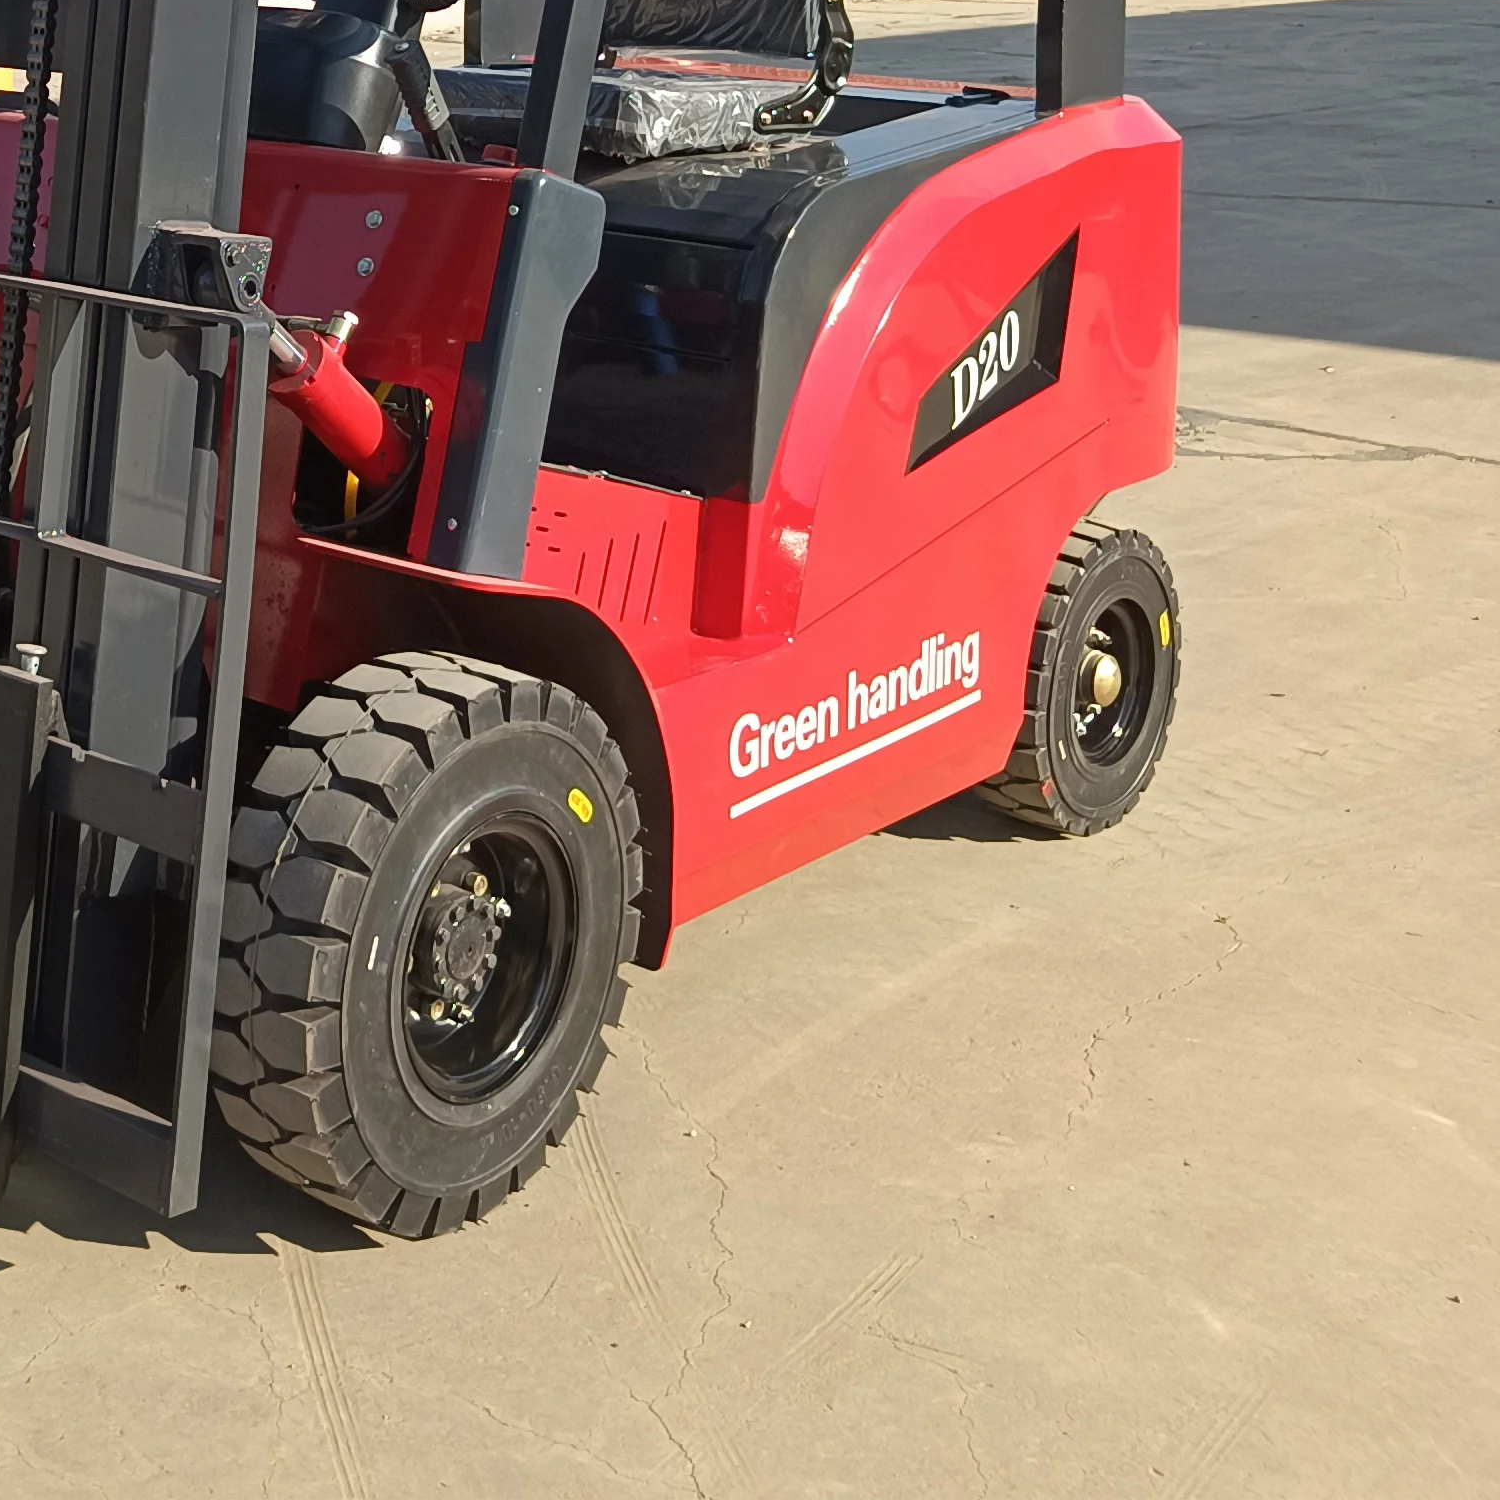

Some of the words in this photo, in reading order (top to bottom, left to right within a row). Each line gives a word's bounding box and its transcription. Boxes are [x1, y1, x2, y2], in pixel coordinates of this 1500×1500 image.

[950, 310, 1020, 430] D20
[729, 696, 839, 778] Green
[847, 631, 980, 731] handling
